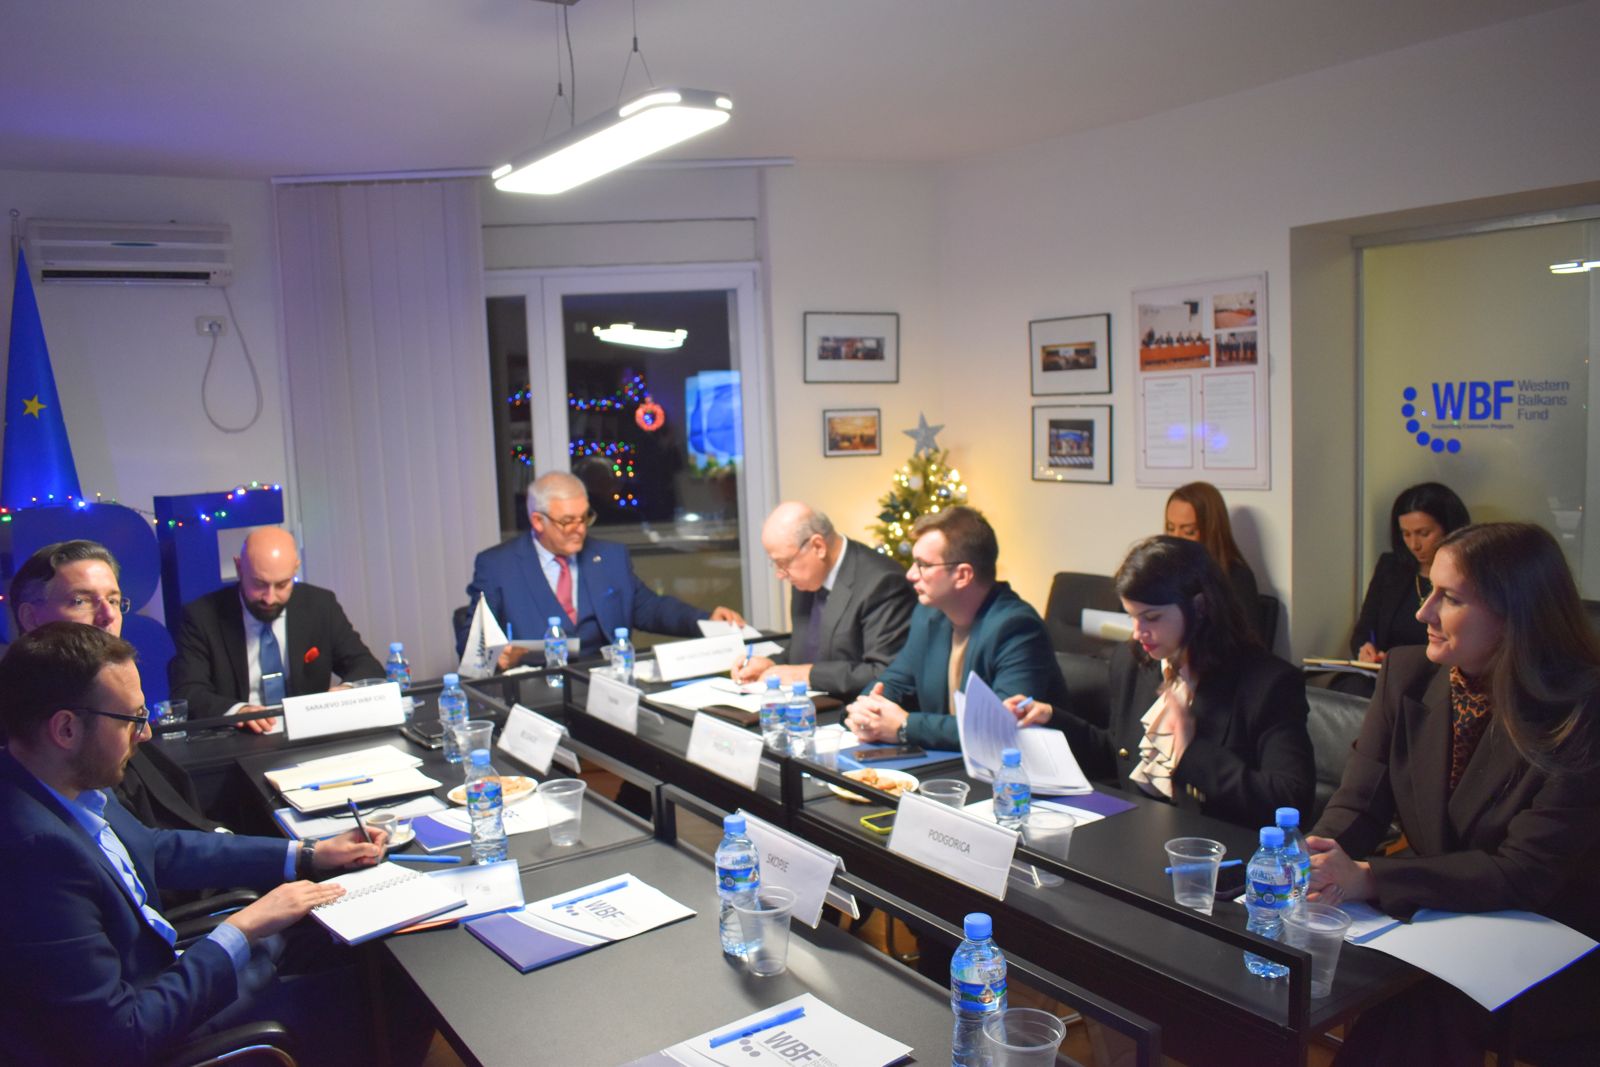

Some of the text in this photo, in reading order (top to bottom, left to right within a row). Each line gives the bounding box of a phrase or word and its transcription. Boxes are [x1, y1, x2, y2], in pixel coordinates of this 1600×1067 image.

[1517, 380, 1569, 391] Western
[1432, 380, 1514, 420] WBF
[1517, 394, 1568, 406] Balkans
[1517, 408, 1549, 420] Fund
[305, 702, 339, 711] SARAJEVO
[928, 829, 970, 854] PODGORICA
[584, 899, 625, 919] WBF
[763, 1030, 822, 1062] WBF
